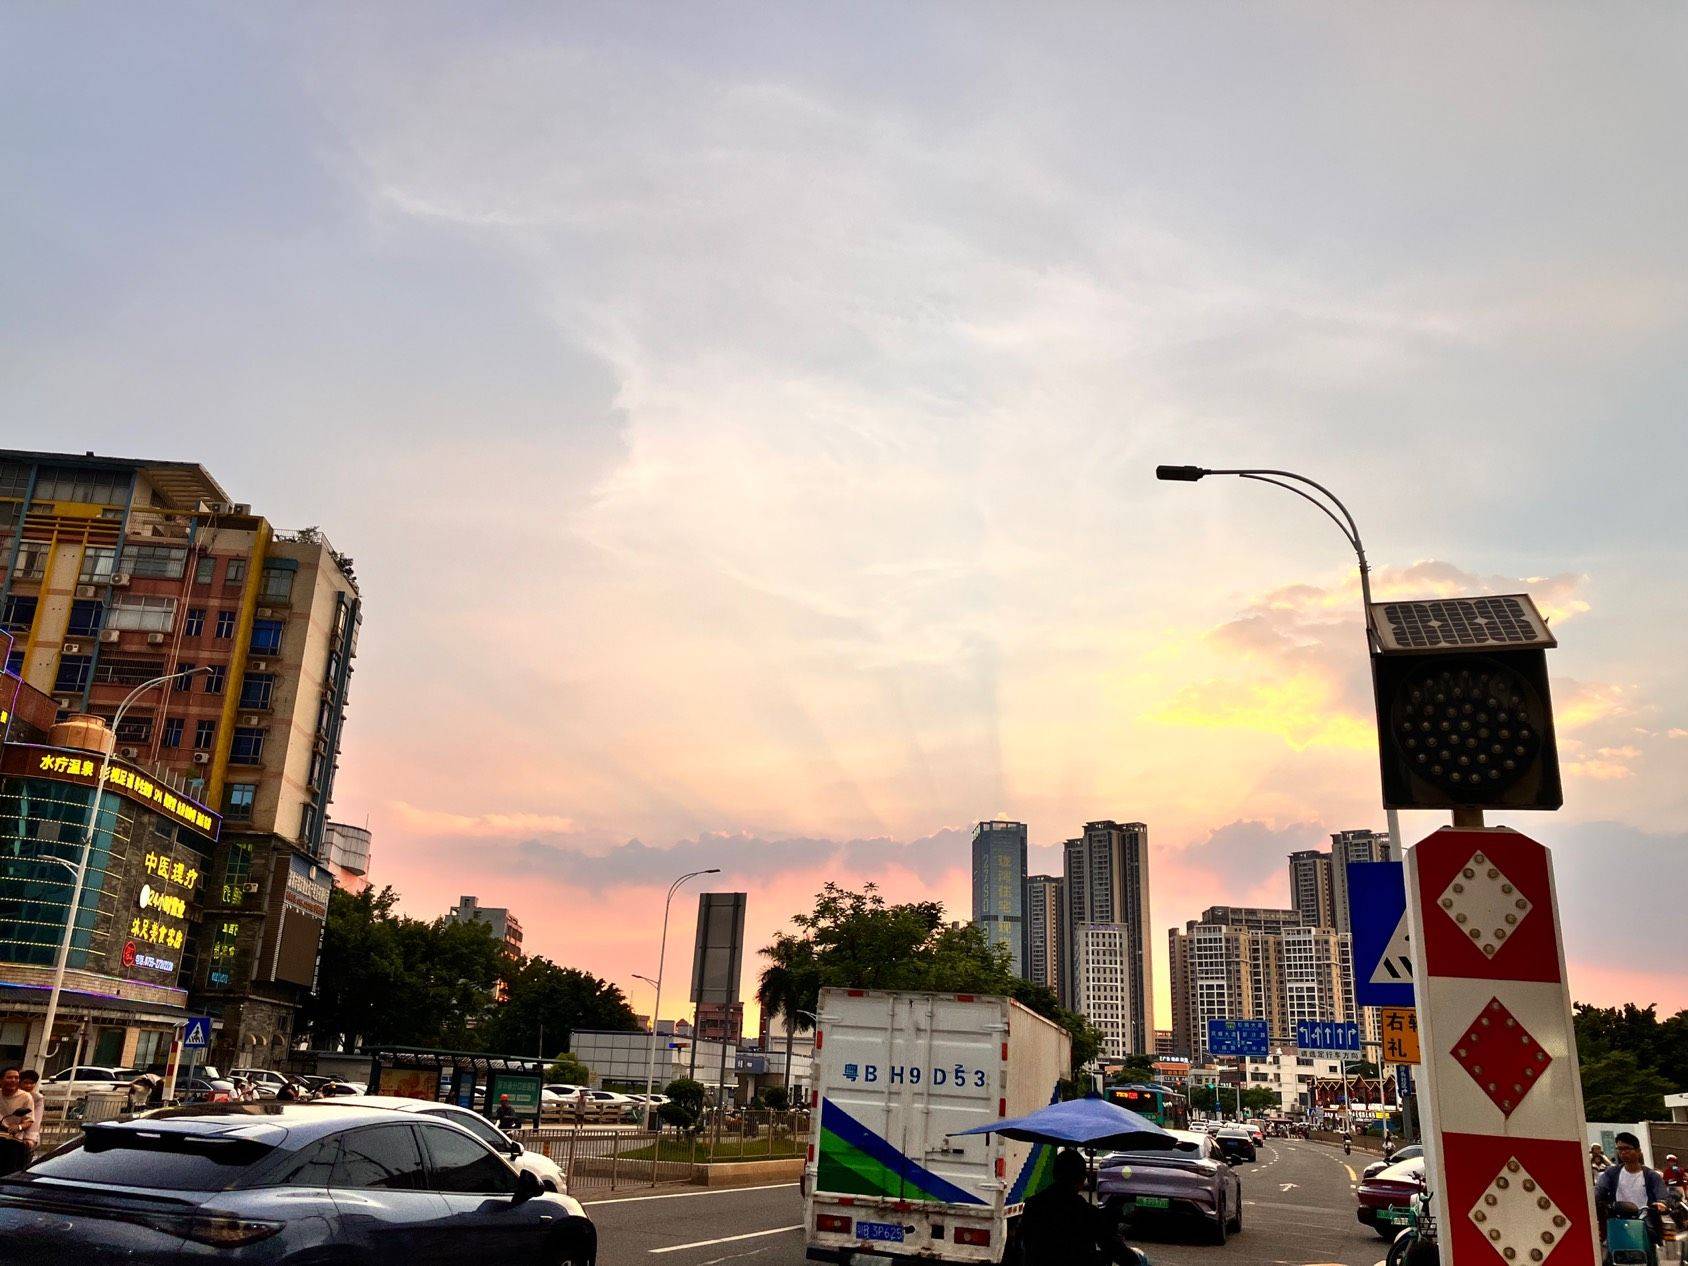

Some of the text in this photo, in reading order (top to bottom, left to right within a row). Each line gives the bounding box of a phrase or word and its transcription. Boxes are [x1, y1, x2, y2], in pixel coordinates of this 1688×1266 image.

[39, 754, 94, 777] 水疗温泉
[145, 851, 199, 890] 中医理疗
